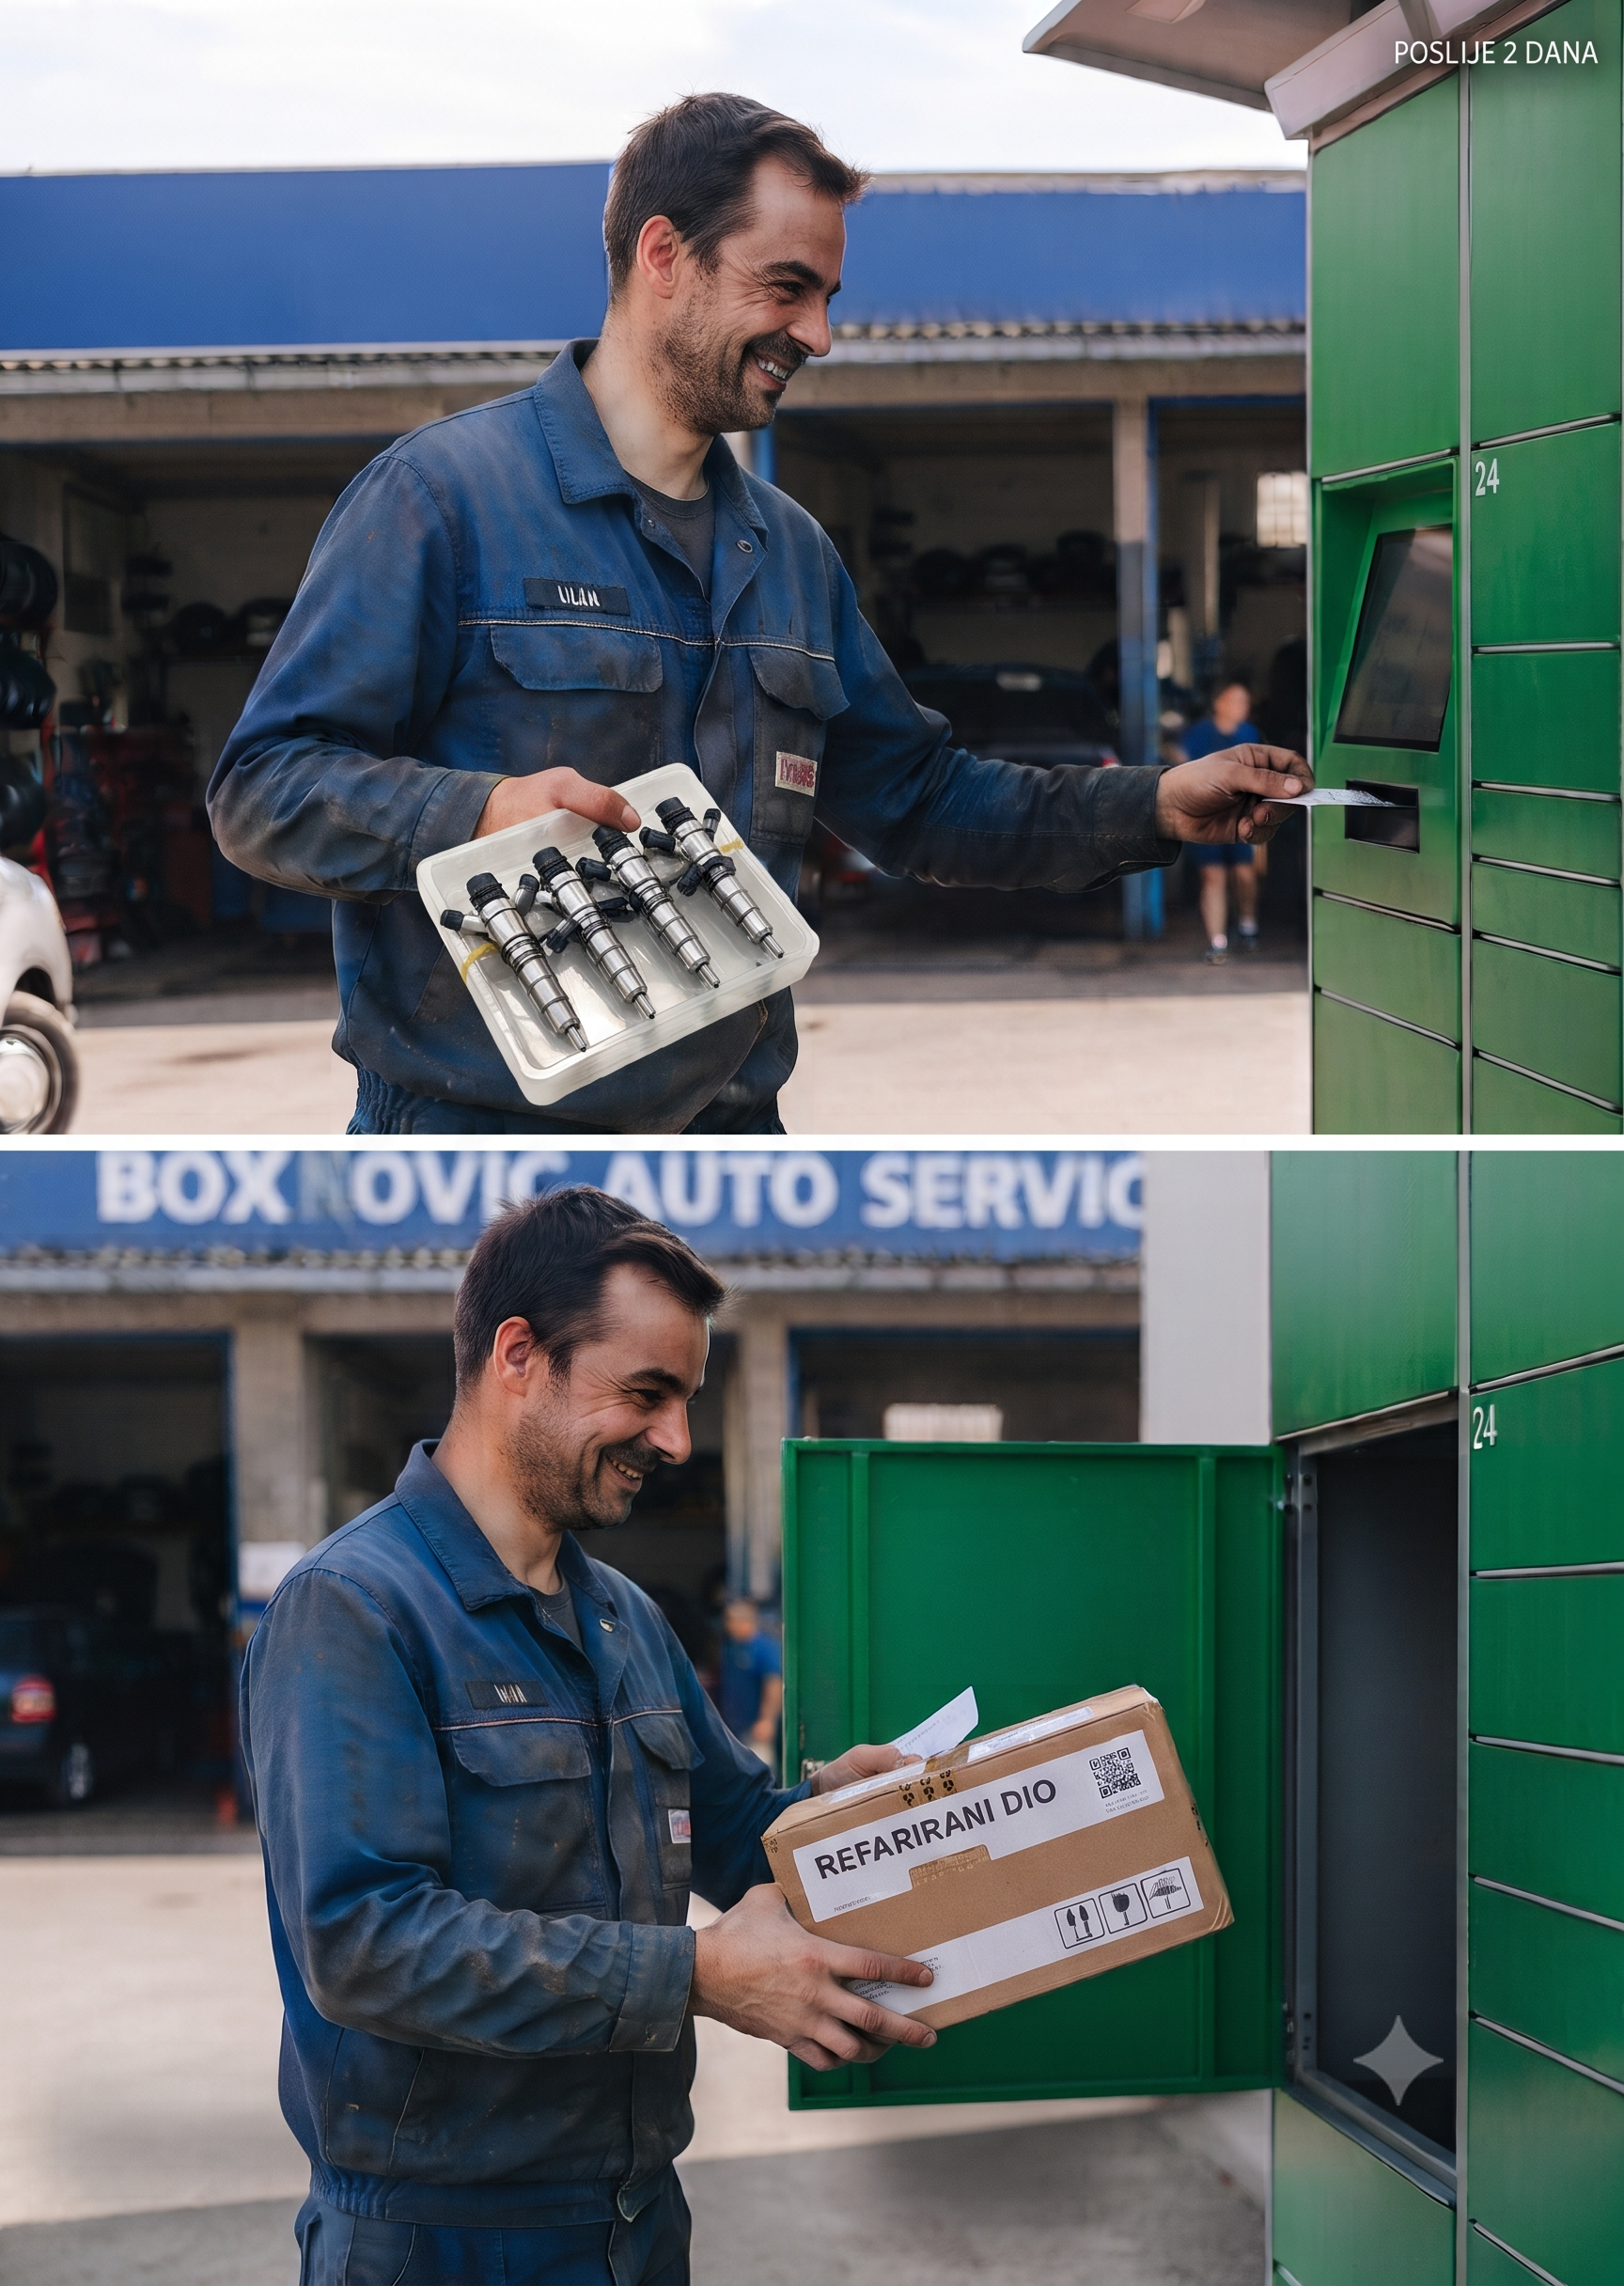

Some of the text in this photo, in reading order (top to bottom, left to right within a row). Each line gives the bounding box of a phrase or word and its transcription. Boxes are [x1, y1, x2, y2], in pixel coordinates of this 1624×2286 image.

[1475, 458, 1500, 496] 24
[96, 1151, 293, 1223] BOX
[601, 1151, 838, 1226] AUTO
[1473, 1403, 1498, 1450] 24
[814, 1798, 995, 1880] REFARIRANI
[999, 1778, 1056, 1816] DIO
